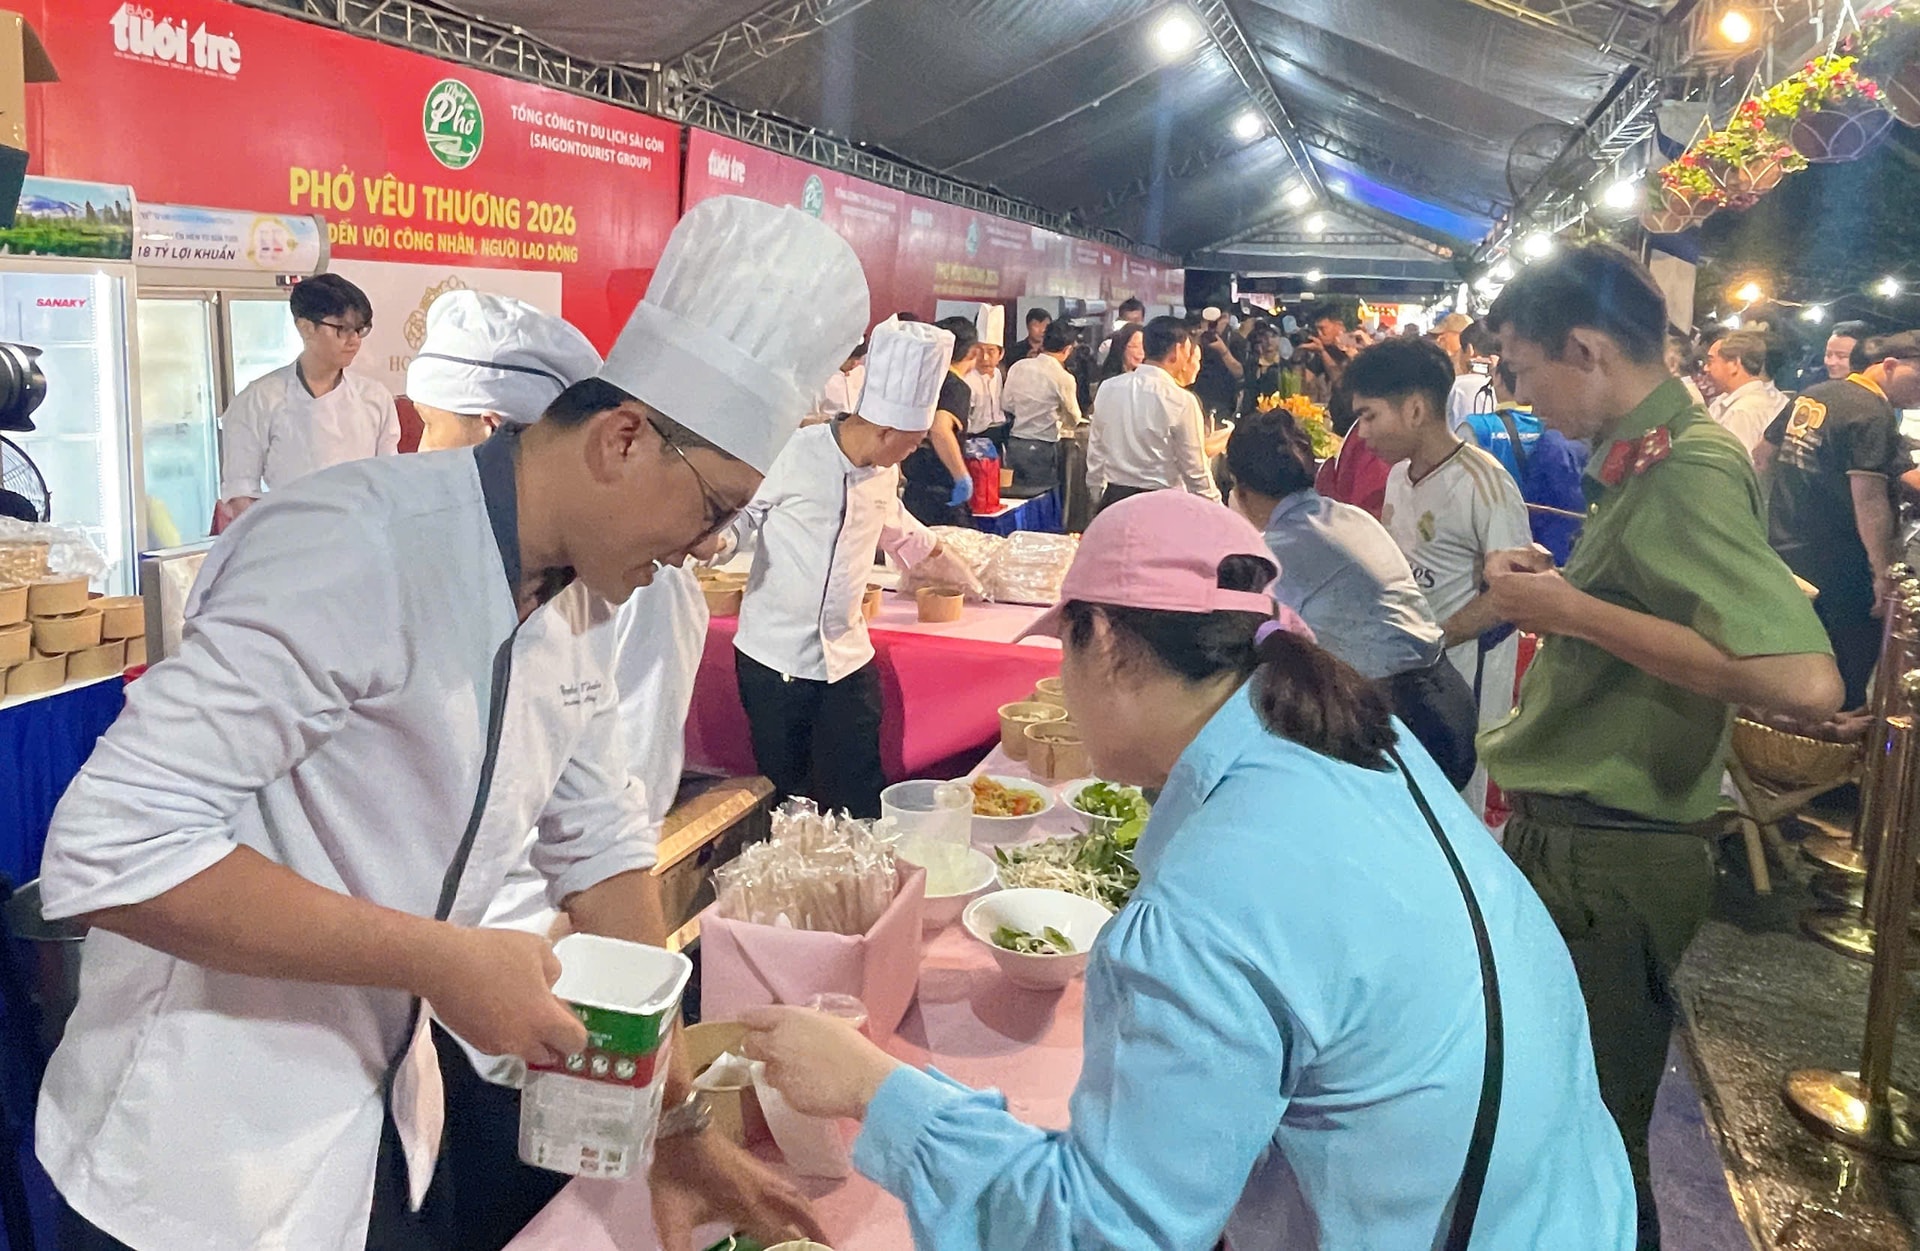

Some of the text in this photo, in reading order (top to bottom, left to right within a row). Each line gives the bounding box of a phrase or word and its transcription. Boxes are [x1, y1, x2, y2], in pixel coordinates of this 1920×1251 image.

[109, 2, 188, 64] tuổi
[190, 21, 241, 75] trẻ
[511, 101, 665, 154] TỔNG CÔNG TY DU LỊCH SÀI GÒN
[529, 131, 652, 172] (SAIGONTOURIST GROUP)
[289, 164, 577, 236] PHỞ YÊU THƯƠNG 2026
[138, 246, 151, 258] 18
[171, 247, 192, 260] LỢI
[194, 244, 236, 260] KHUẨN
[327, 218, 359, 246] ĐẾN
[362, 223, 390, 249] VỚI
[393, 225, 434, 252] CÔNG
[481, 236, 520, 259] NGƯỜI
[521, 240, 545, 261] LAO
[547, 241, 579, 265] ĐỘNG
[36, 298, 87, 308] SANAKY
[389, 355, 411, 371] HO
